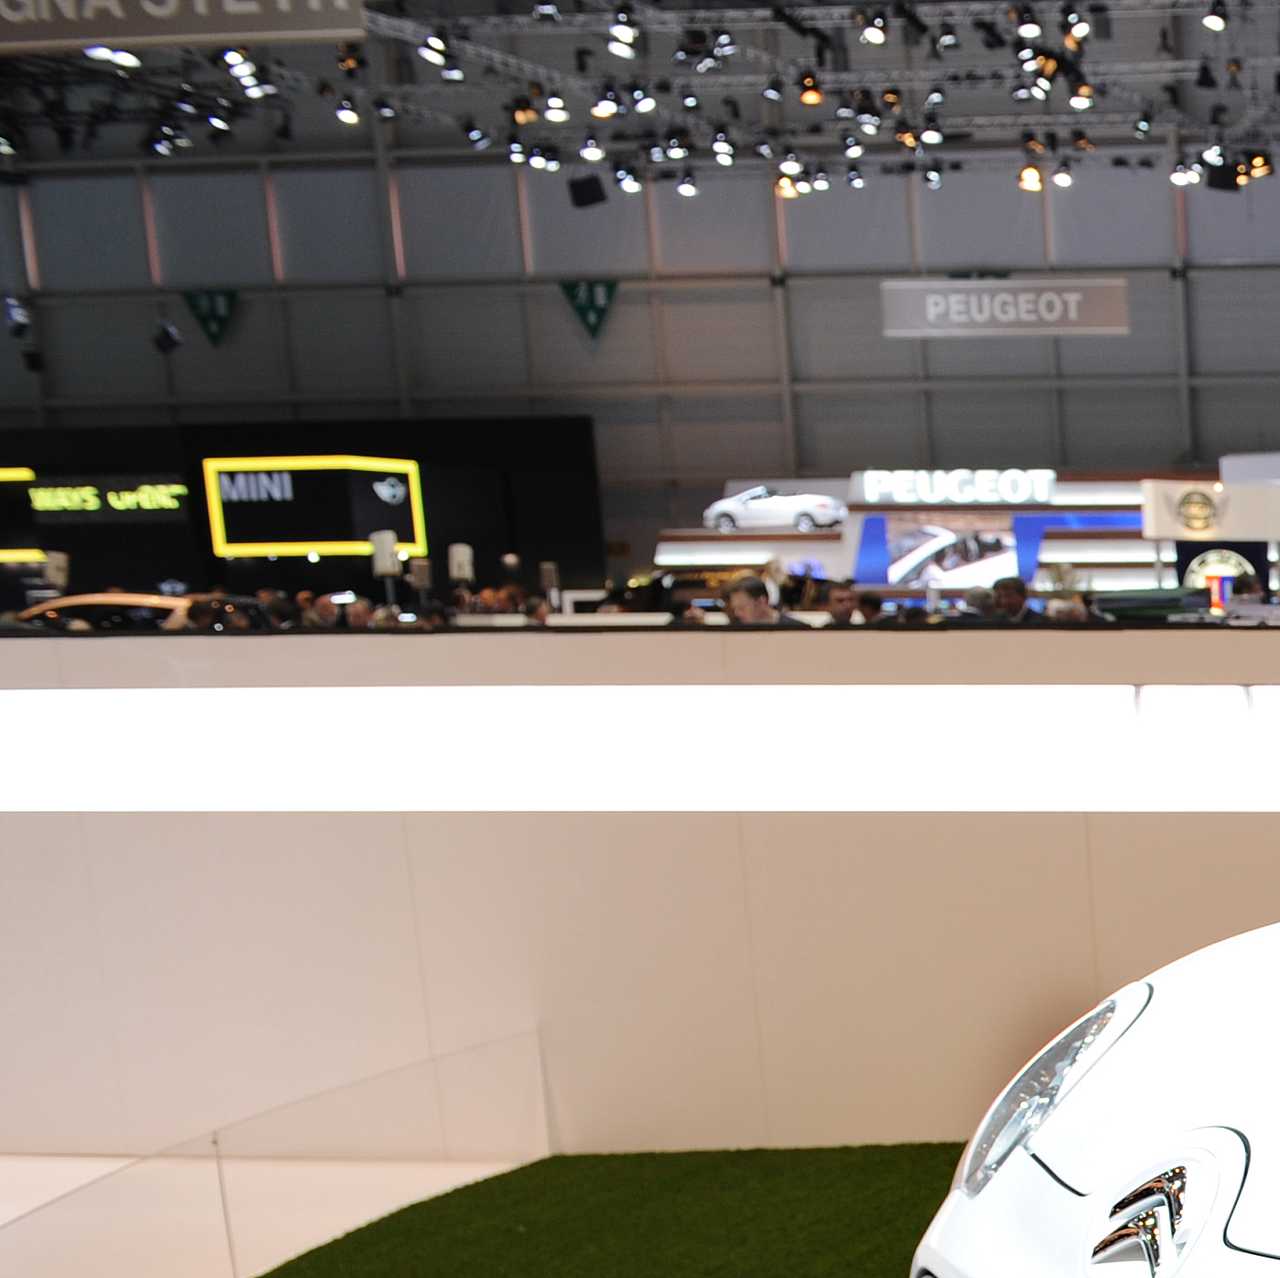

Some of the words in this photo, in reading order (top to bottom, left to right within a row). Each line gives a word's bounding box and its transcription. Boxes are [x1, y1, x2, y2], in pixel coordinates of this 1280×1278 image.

[924, 291, 1084, 324] PEUGEOT
[219, 471, 294, 502] MINI
[862, 468, 1057, 504] PEUGEOT
